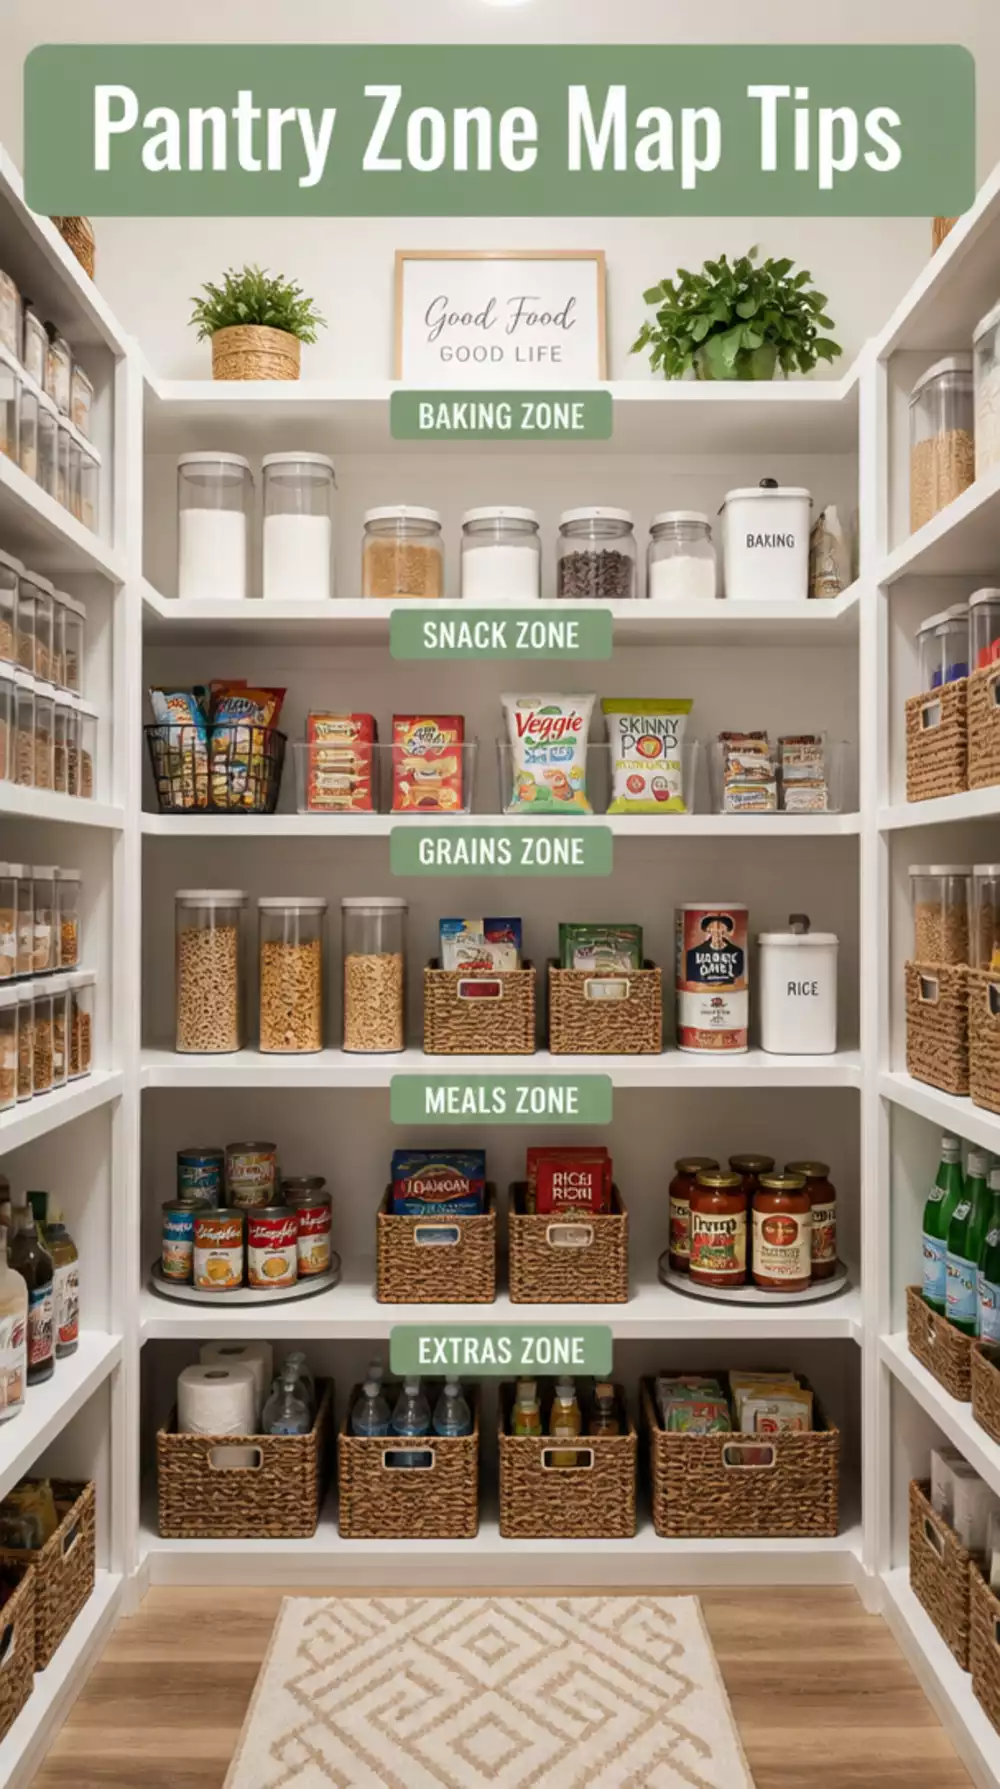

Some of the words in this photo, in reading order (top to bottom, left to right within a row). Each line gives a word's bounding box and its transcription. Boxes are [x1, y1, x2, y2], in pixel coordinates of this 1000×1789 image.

[424, 295, 498, 342] Good
[505, 296, 577, 335] Food
[439, 345, 504, 363] GOOD
[514, 345, 562, 363] LIFE
[745, 532, 796, 550] BAKING
[514, 711, 583, 741] Veggie
[618, 716, 679, 734] SKINNY
[620, 734, 678, 759] POP
[787, 980, 820, 997] RICE
